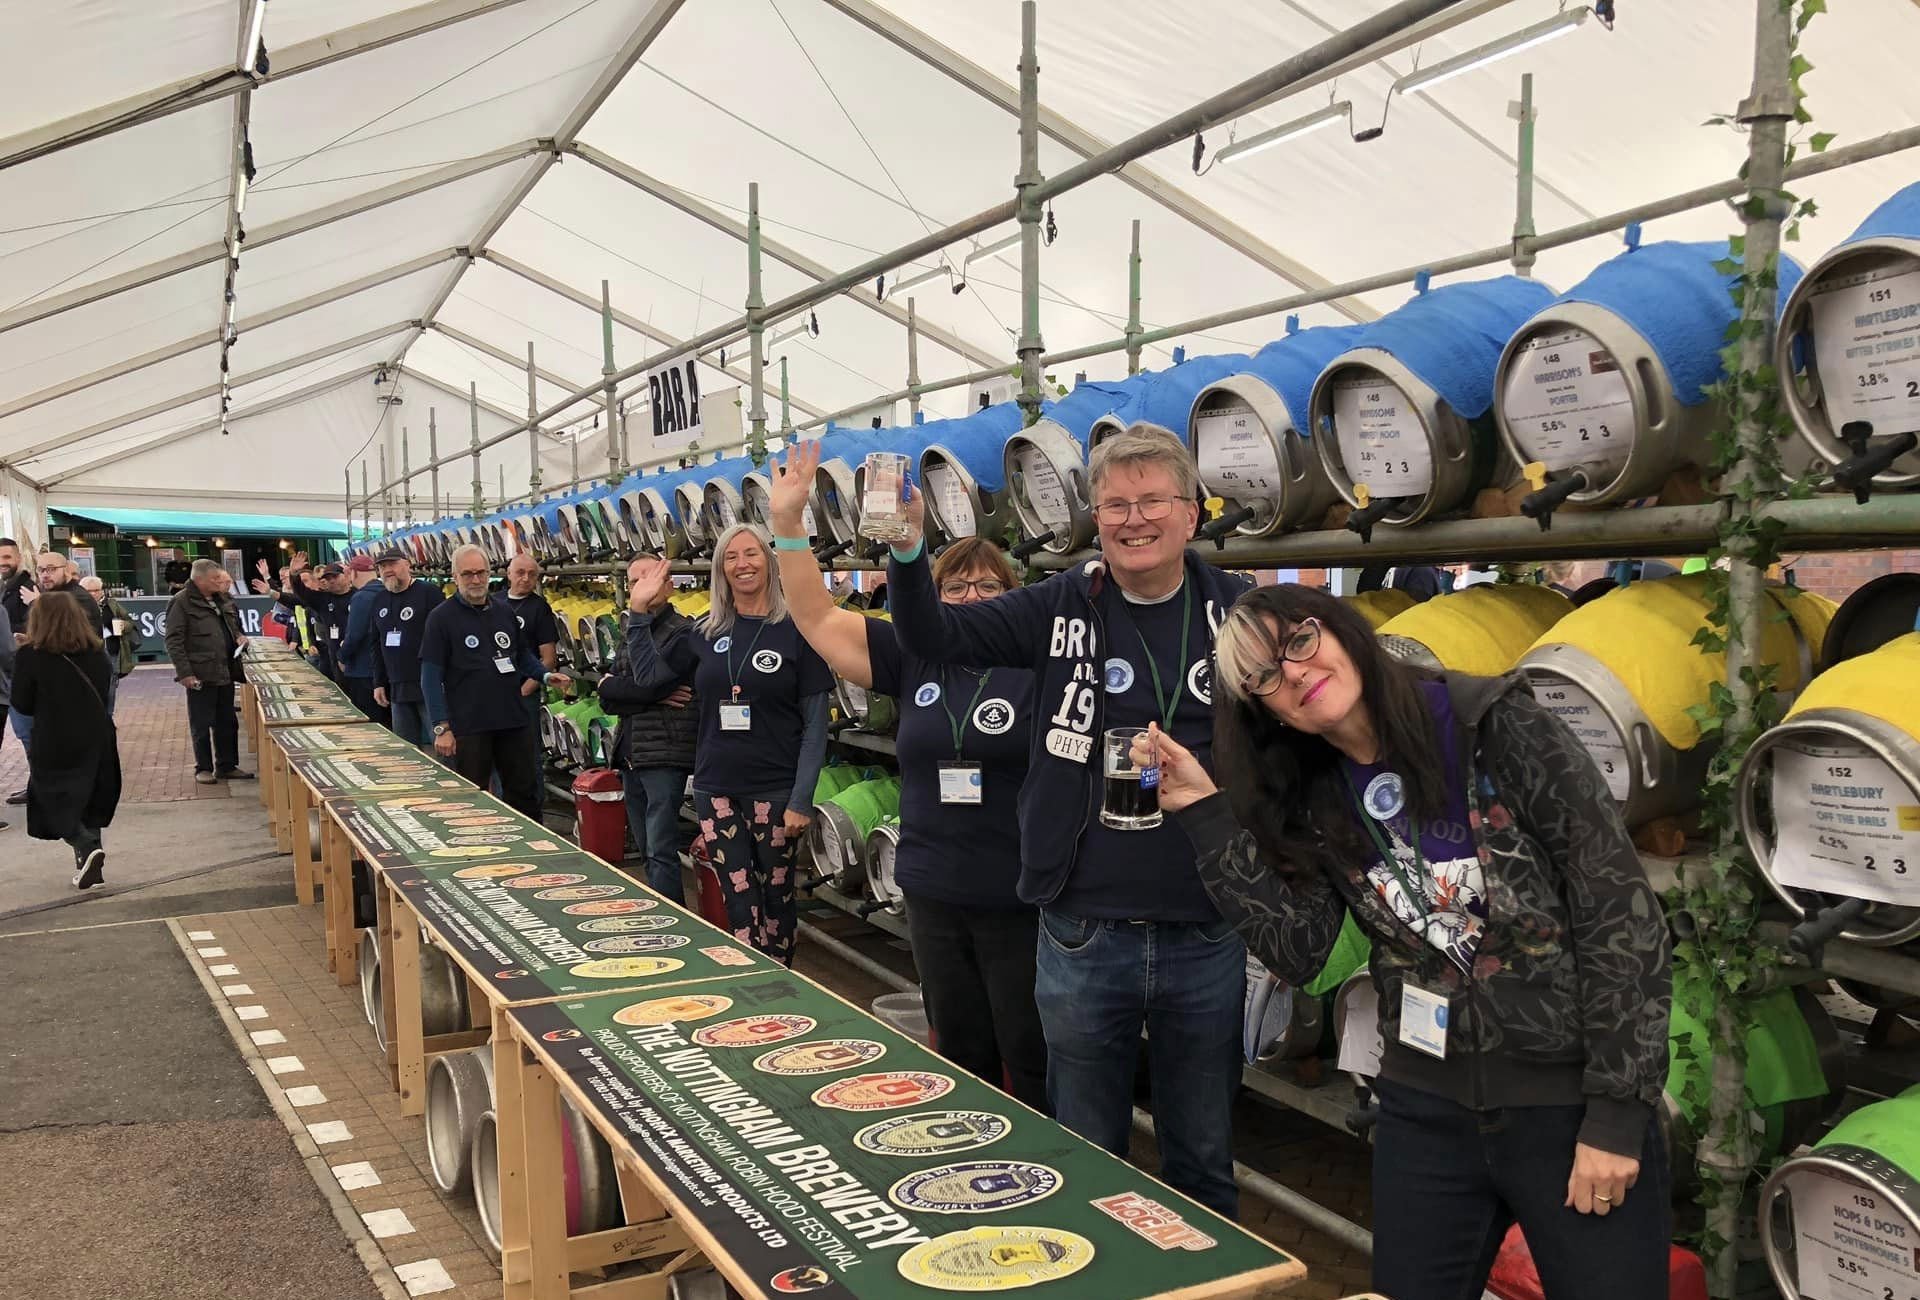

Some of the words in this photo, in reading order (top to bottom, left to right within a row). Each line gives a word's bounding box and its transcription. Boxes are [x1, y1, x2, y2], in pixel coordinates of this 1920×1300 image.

[1869, 289, 1891, 302] 151
[1543, 354, 1560, 364] 148
[1858, 373, 1888, 387] 3.8%
[1906, 381, 1920, 397] 2
[649, 367, 688, 436] BAR
[1541, 420, 1566, 431] 5.6%
[1580, 428, 1589, 440] 2
[1600, 425, 1610, 437] 3
[1385, 462, 1392, 473] 2
[1401, 462, 1409, 473] 3
[1247, 479, 1255, 488] 2
[239, 609, 261, 633] AR
[1546, 692, 1565, 700] 149
[1052, 681, 1095, 733] 19
[1551, 706, 1590, 715] RISON'S
[1142, 768, 1159, 776] CAST
[1604, 761, 1614, 774] 3
[1828, 767, 1852, 777] 152
[1811, 783, 1884, 799] HARTLEBURY
[1816, 811, 1834, 822] OFF
[1836, 813, 1854, 824] THE
[1864, 856, 1876, 870] 2
[1894, 859, 1907, 874] 3
[471, 887, 548, 930] NOTTINGHAM
[520, 927, 596, 965] BREWERY
[592, 1028, 627, 1053] PROUD
[626, 1022, 688, 1052] THE
[615, 1049, 672, 1094] SUPPORTERS
[653, 1047, 804, 1150] NOTTINGHAM
[658, 1091, 685, 1105] OF
[945, 1112, 993, 1122] ROCK
[669, 1103, 737, 1157] NOTTINGHAM
[726, 1155, 774, 1188] ROBIN
[1007, 1164, 1056, 1195] LEGEND
[666, 1138, 722, 1184] MARKETING
[711, 1183, 770, 1229] PRODUCTS
[757, 1228, 788, 1249] LTD
[758, 1185, 807, 1218] HOOD
[765, 1144, 932, 1250] BREWERY
[1853, 1195, 1875, 1209] 153
[911, 1199, 966, 1211] BREWERY
[1834, 1205, 1861, 1224] HOPS
[1864, 1216, 1871, 1227] &
[1874, 1219, 1905, 1238] DOTS
[793, 1215, 862, 1273] FESTIVAL
[1837, 1257, 1868, 1277] 5.5%
